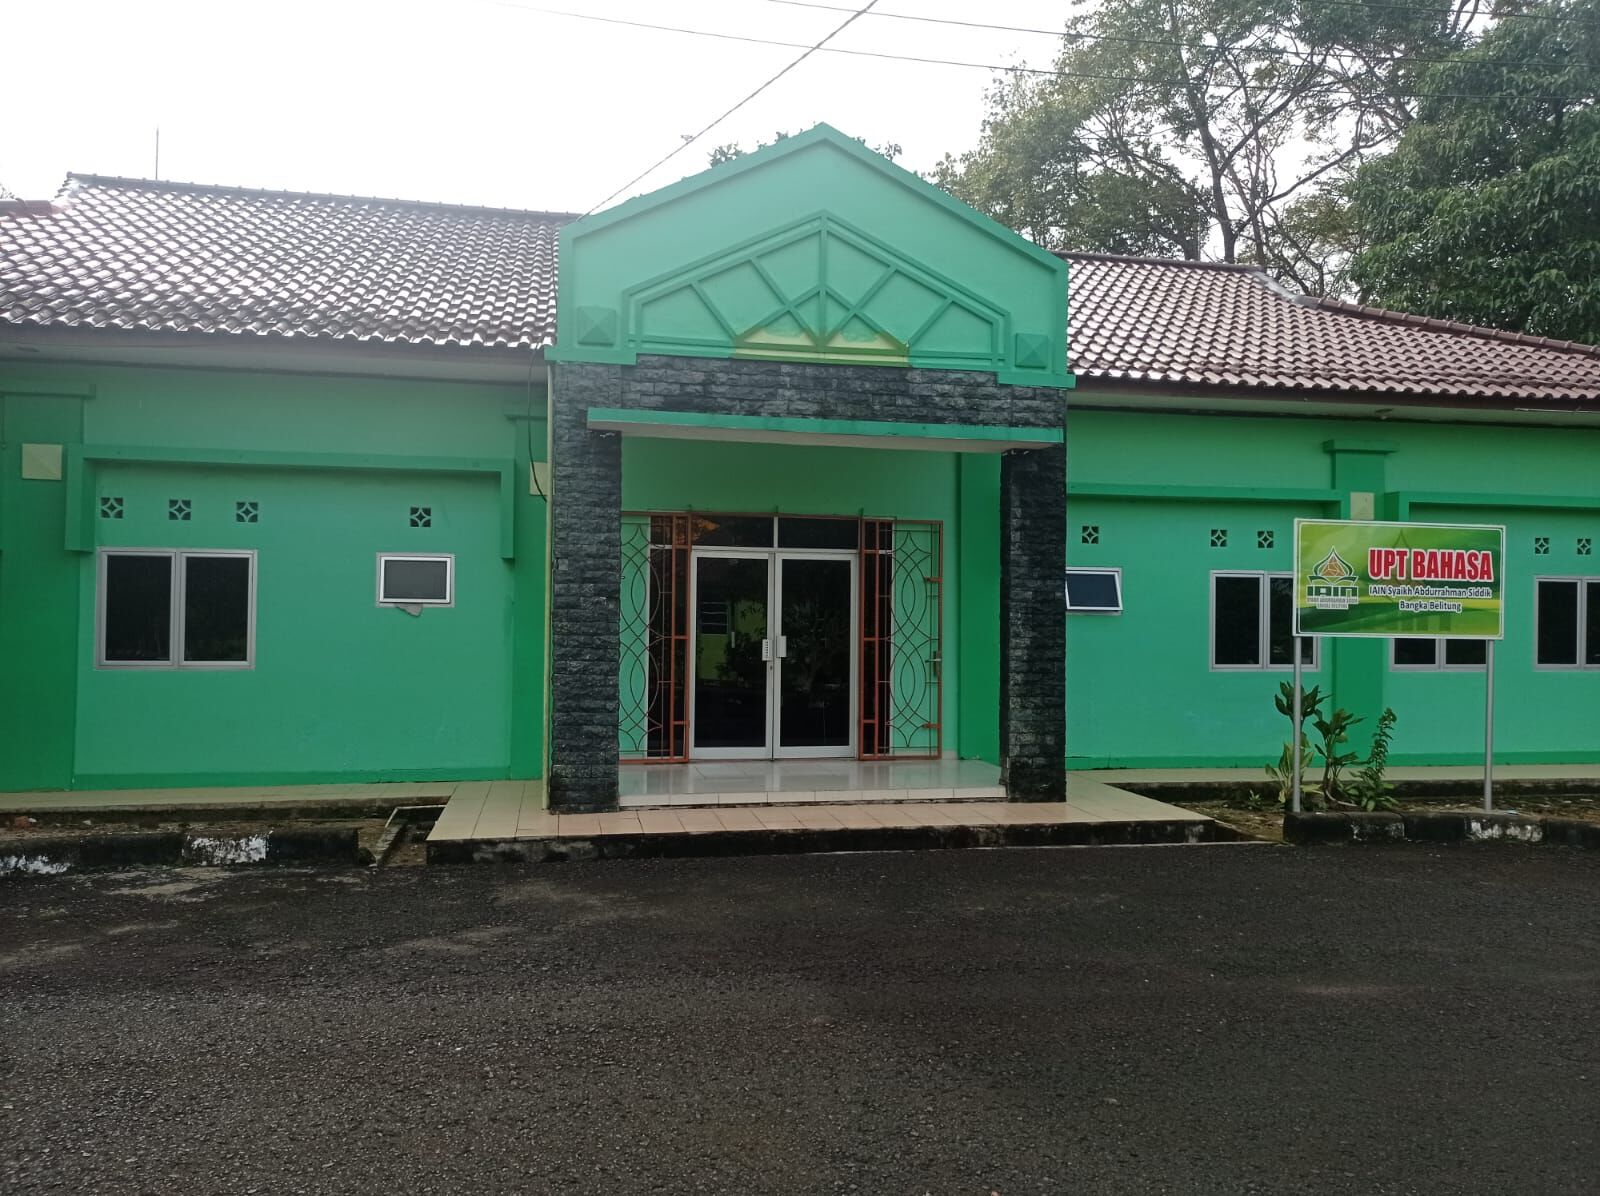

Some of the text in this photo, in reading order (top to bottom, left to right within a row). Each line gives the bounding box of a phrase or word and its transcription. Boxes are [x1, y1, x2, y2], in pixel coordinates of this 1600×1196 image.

[1369, 548, 1494, 582] UPT BAHASA
[1369, 585, 1492, 598] IAIN Syaikh Abdurrahman Siddik
[1399, 601, 1462, 613] Bangka Belitung
